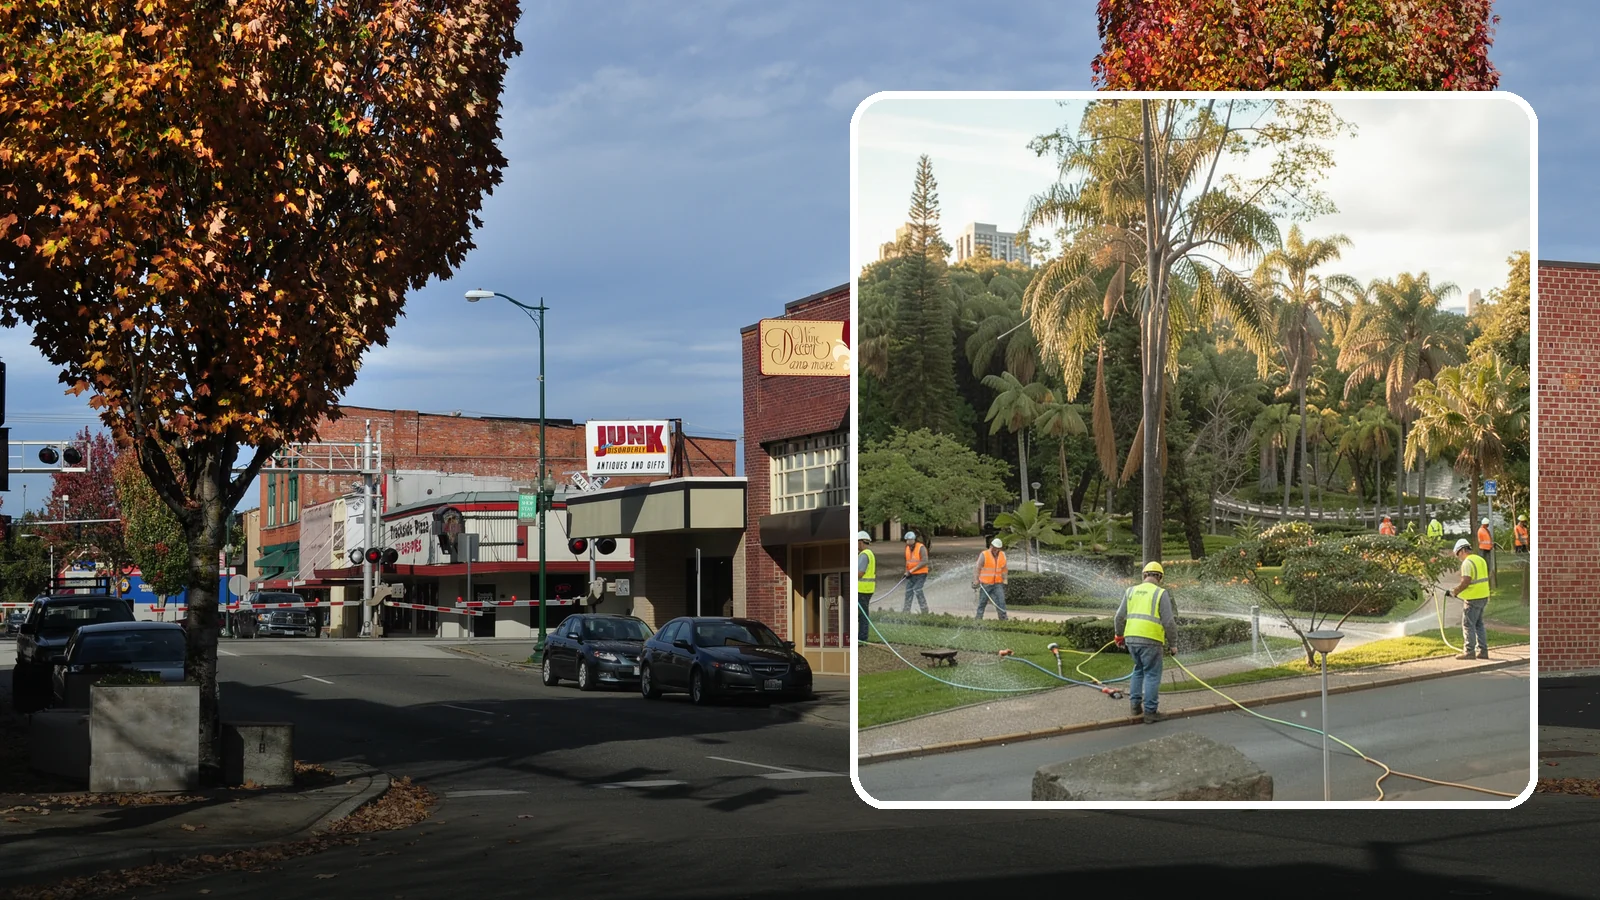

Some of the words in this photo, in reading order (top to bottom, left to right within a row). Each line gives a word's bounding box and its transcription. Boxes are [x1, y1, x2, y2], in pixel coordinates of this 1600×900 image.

[765, 327, 831, 366] Decor
[595, 425, 665, 457] JUNK
[607, 446, 646, 454] DISORDERLY
[597, 461, 628, 470] ANTIQUES
[631, 461, 644, 470] AND
[647, 460, 666, 469] GIFTS
